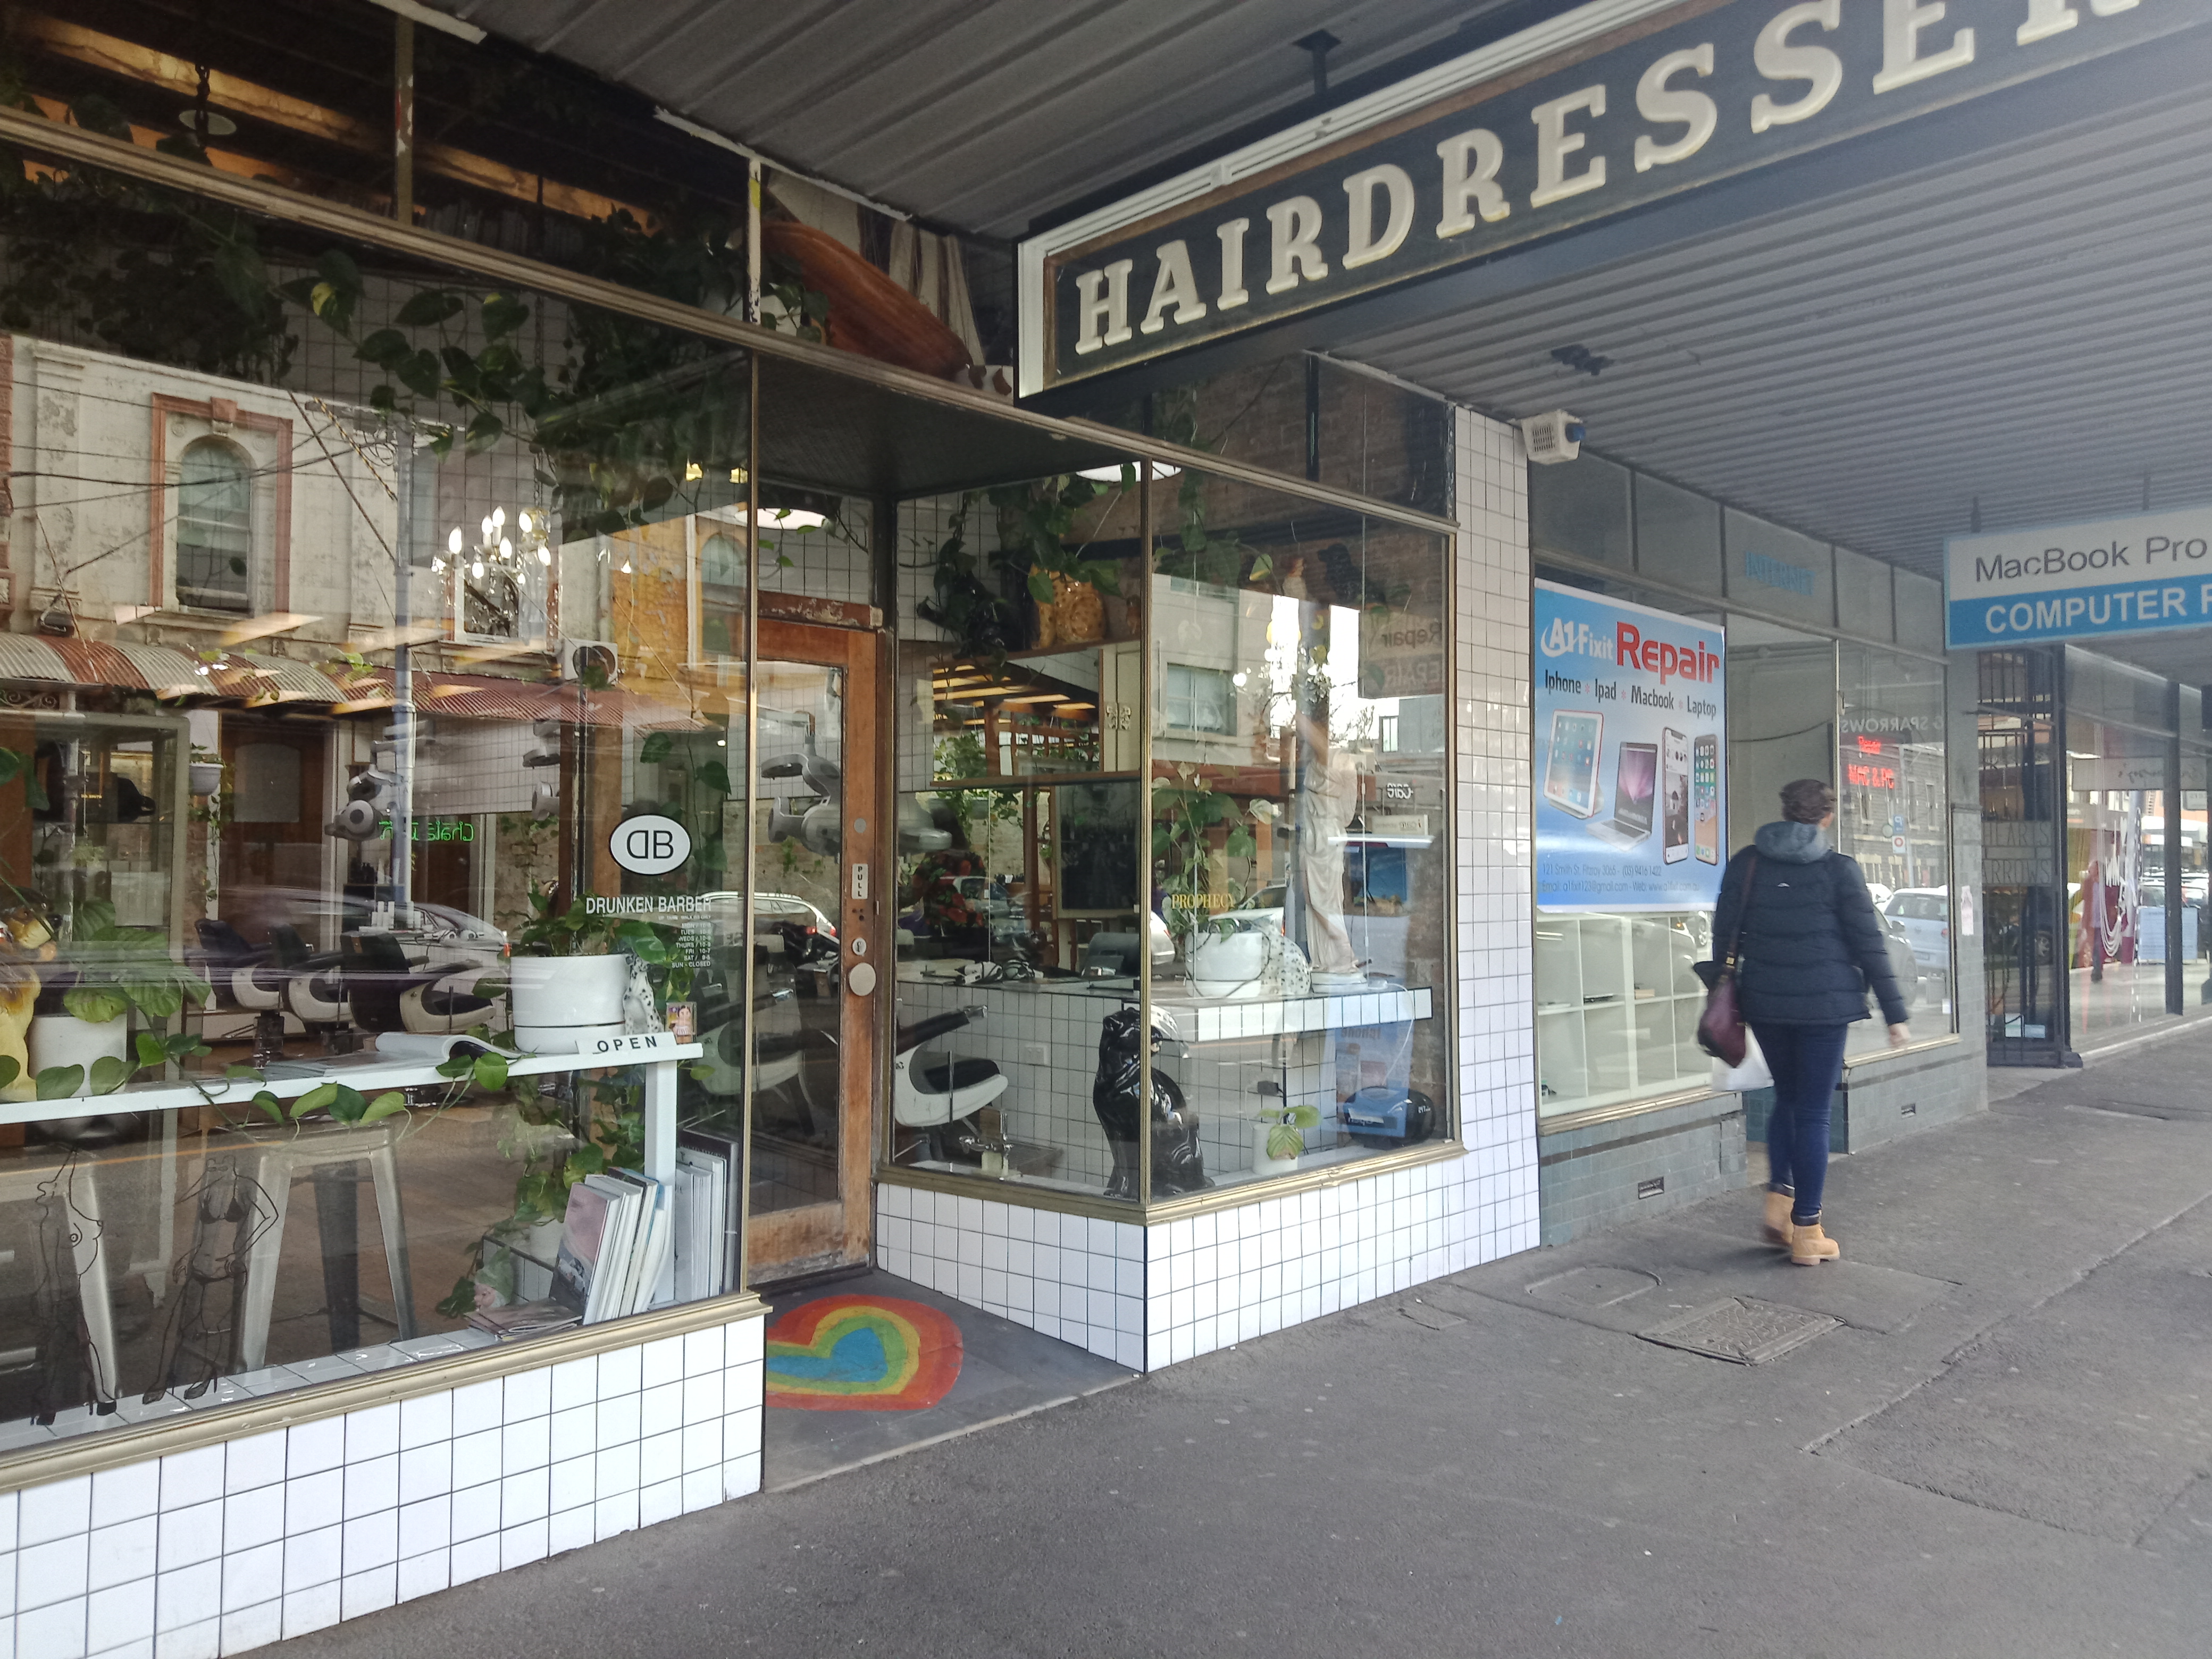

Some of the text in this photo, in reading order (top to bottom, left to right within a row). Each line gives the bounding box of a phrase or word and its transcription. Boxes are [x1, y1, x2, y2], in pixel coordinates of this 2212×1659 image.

[1975, 536, 2208, 582] MacBook Pro
[1985, 587, 2186, 633] COMPUTER
[1616, 621, 1720, 685] Repair
[1545, 669, 1716, 720] Iphone Ipad Macbook Laptop
[626, 830, 674, 859] DB
[1543, 864, 1553, 875] 121
[1555, 863, 1572, 875] Smith
[1582, 864, 1601, 877] Fitzroy
[1603, 864, 1616, 876] 3065
[1622, 865, 1633, 877] (03)
[586, 895, 711, 914] DRUNKEN BARBER
[1171, 893, 1235, 910] PROPHECY
[597, 1036, 658, 1053] OPEN
